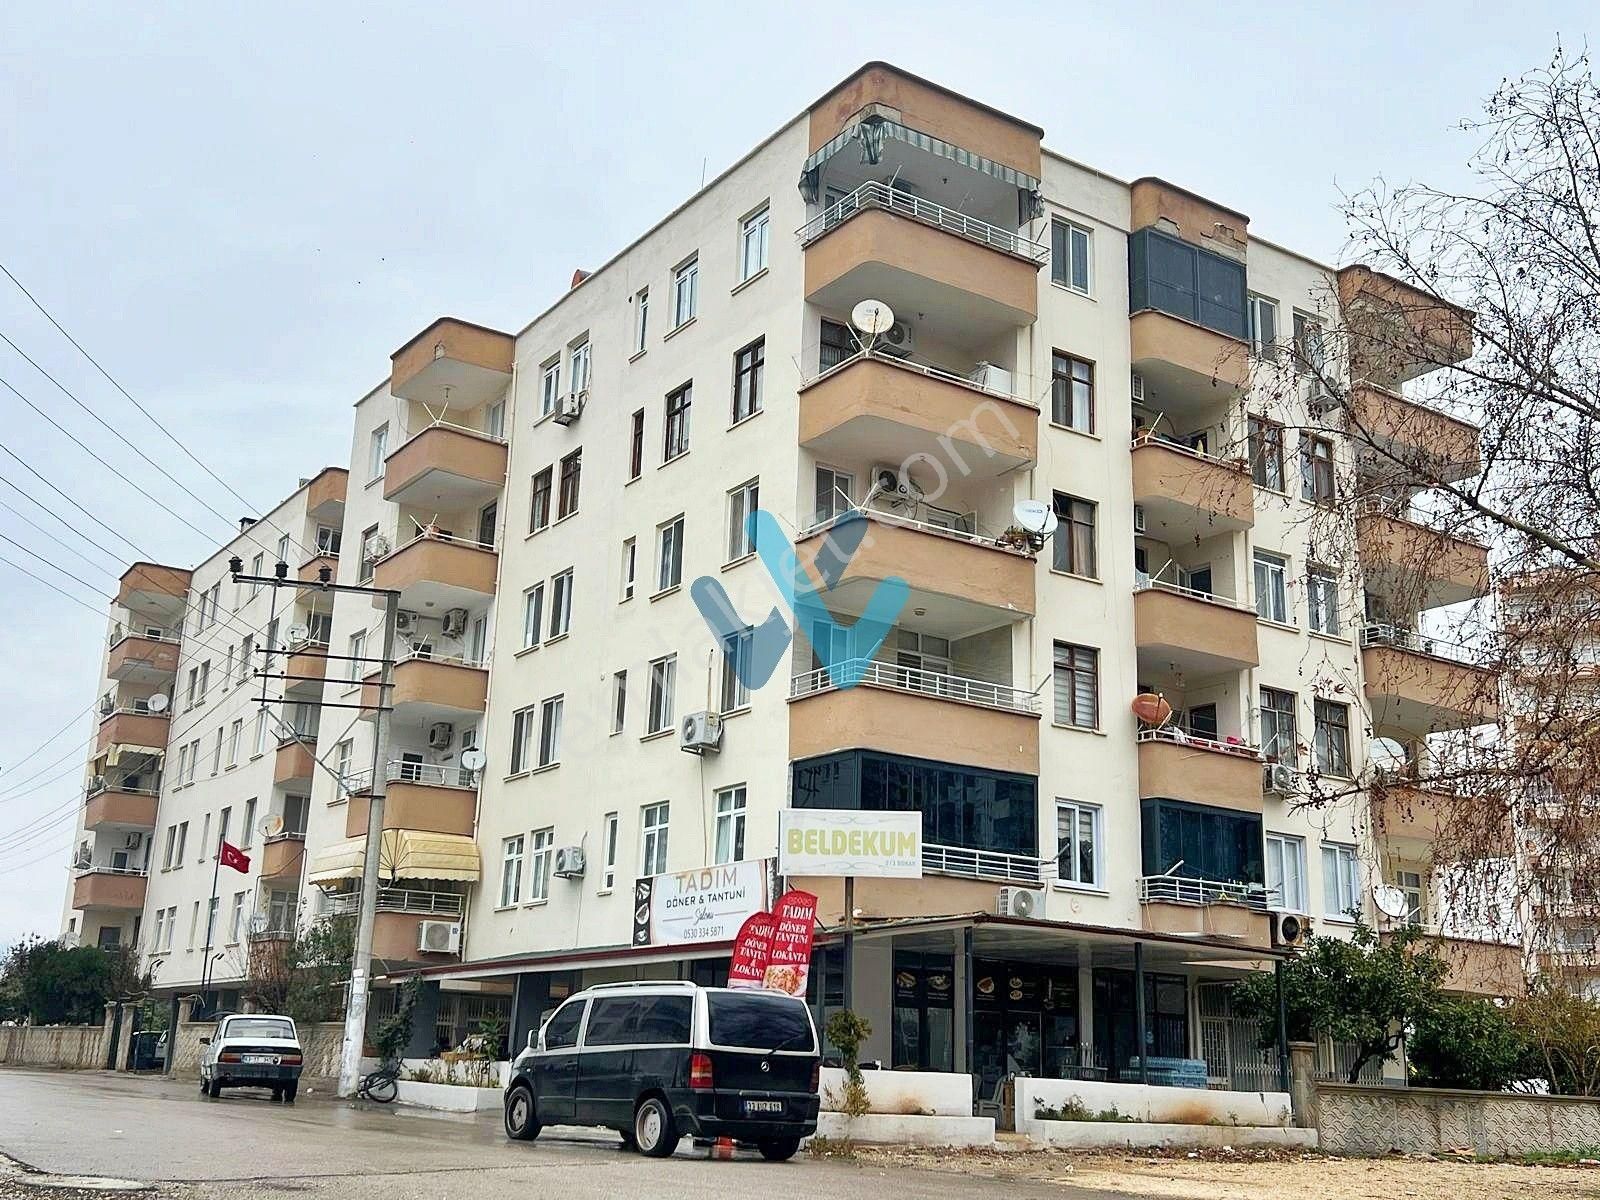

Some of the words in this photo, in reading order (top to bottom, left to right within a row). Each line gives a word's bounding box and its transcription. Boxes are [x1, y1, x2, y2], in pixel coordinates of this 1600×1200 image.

[787, 828, 916, 857] BELDEKUM
[676, 867, 737, 894] TADIM
[666, 895, 696, 908] DÖNER
[698, 894, 705, 905] &
[783, 904, 813, 921] TADIM
[683, 928, 698, 939] 0530
[698, 927, 709, 938] 334
[710, 926, 724, 937] 5871
[779, 921, 807, 934] DÖNER
[744, 938, 768, 951] DÖNER
[740, 946, 766, 961] TANTUN
[771, 949, 807, 963] LOKANTA
[733, 963, 764, 978] LOKANT
